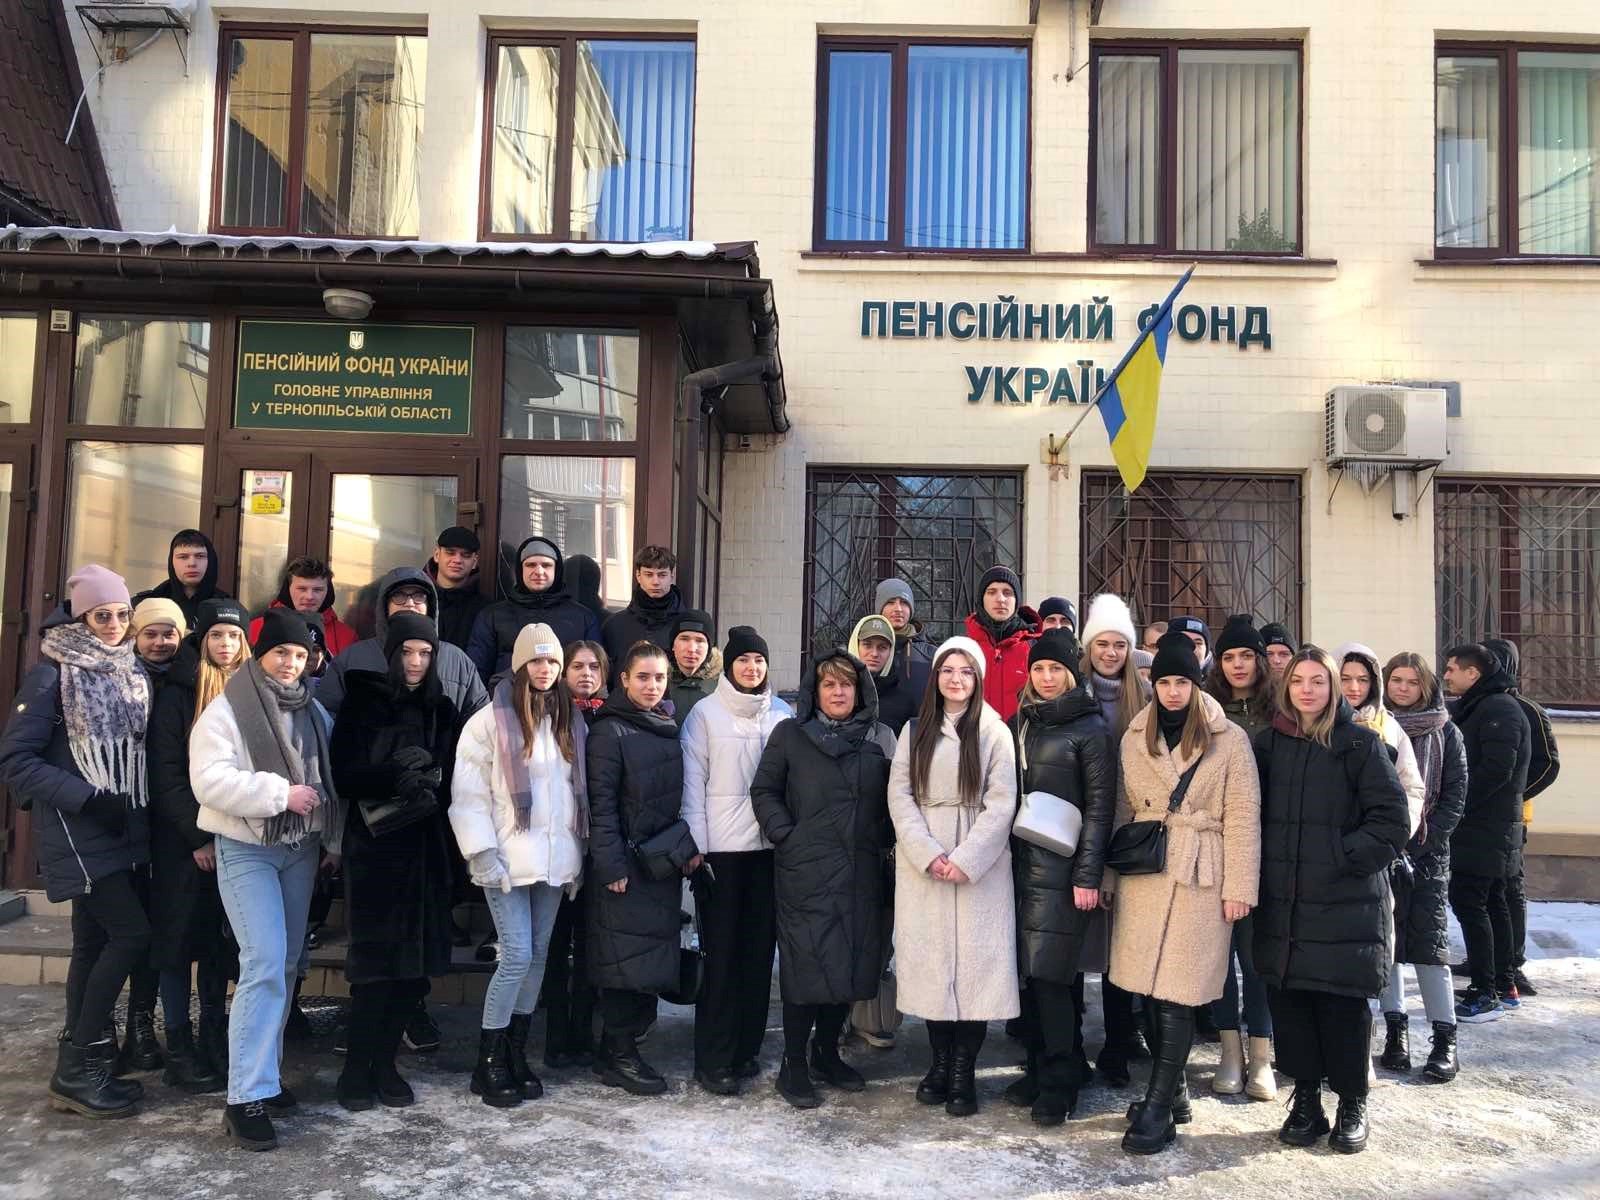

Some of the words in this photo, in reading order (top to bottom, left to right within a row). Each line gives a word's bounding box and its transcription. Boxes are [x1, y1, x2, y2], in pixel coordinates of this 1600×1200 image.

[861, 294, 1113, 340] ПЕНСІЙНИЙ
[243, 351, 340, 373] ПЕНСІЙНИЙ
[344, 355, 395, 377] ФОНД
[399, 356, 468, 376] УКРАЇНИ
[273, 383, 340, 398] ГОЛОВНЕ
[344, 385, 433, 400] УПРАВЛІННЯ
[964, 359, 1114, 404] УКРАЇ
[251, 402, 261, 415] У
[266, 402, 387, 418] ТЕРНОПІЛЬСЬКІЙ
[390, 406, 452, 420] ОБЛАСТІ
